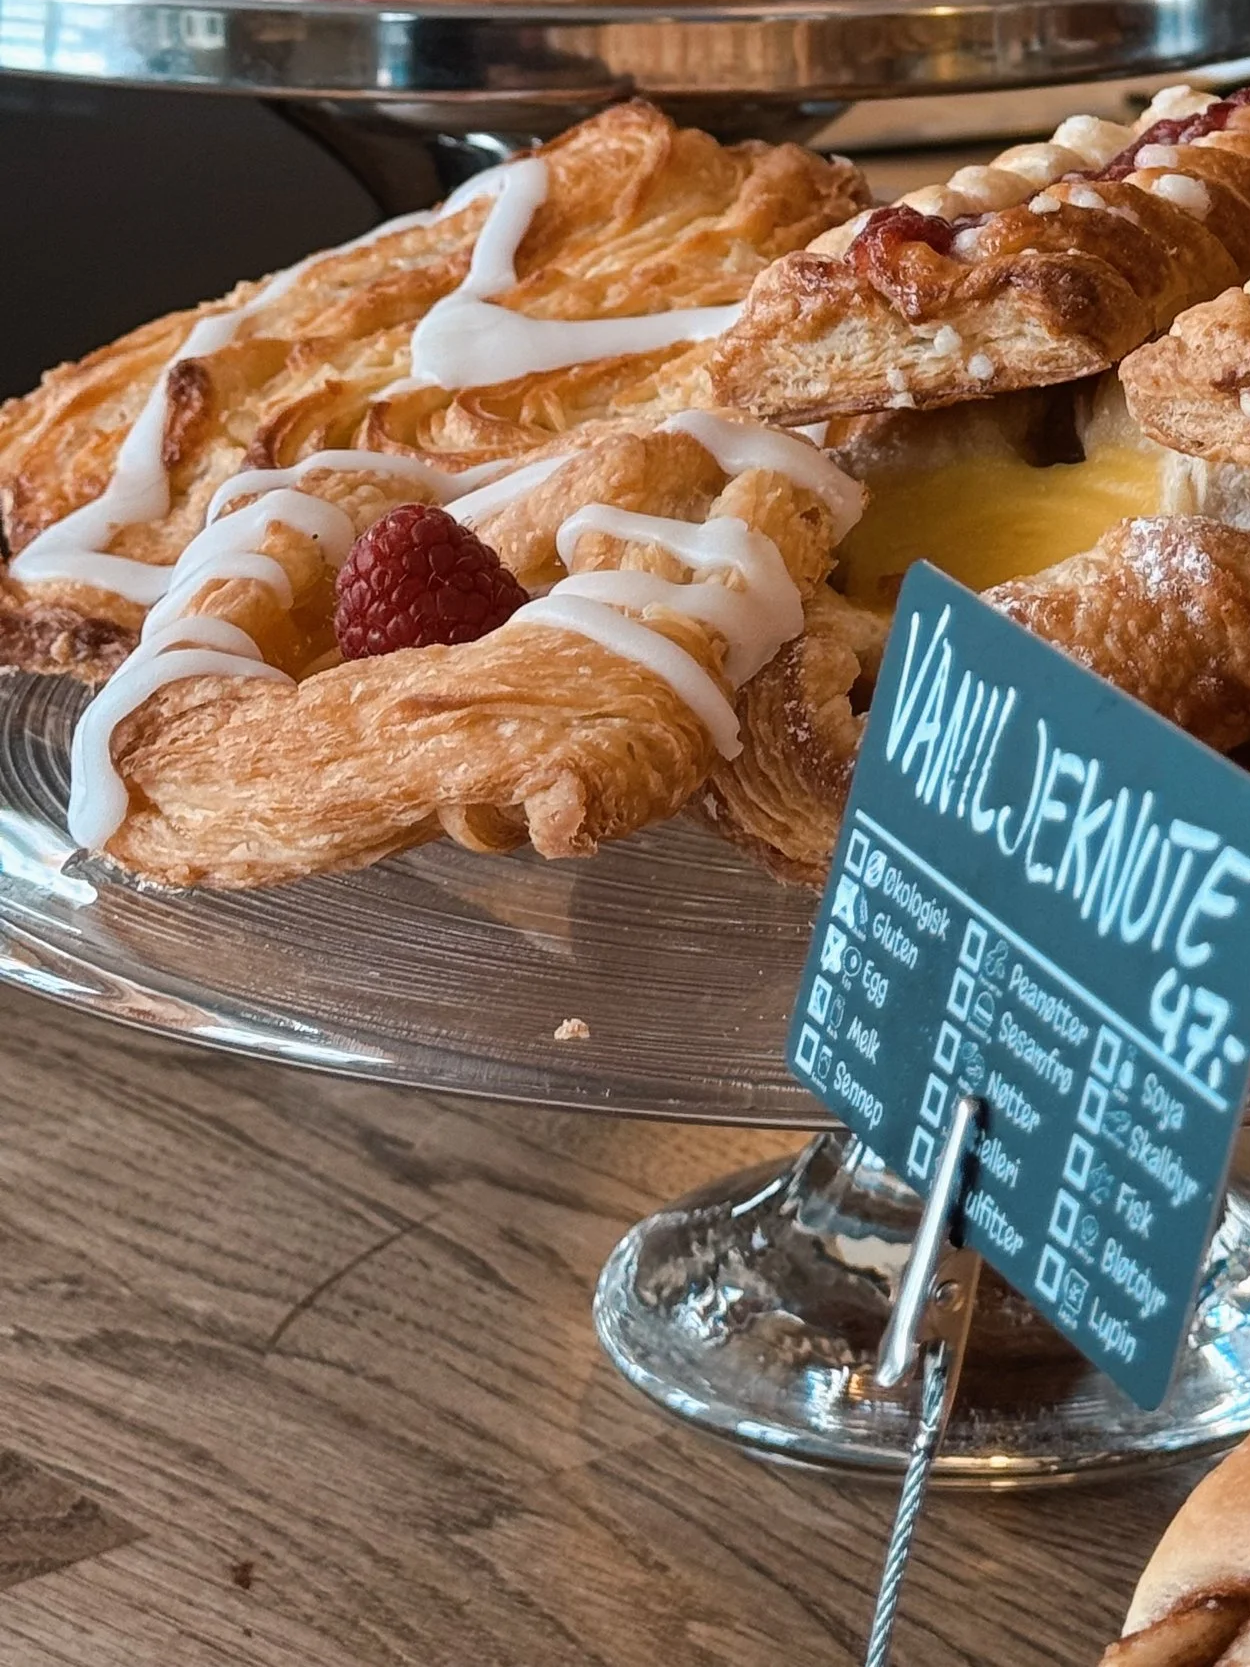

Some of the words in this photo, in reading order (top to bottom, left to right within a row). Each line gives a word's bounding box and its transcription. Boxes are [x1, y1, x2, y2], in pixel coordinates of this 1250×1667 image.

[883, 866, 951, 941] Økologisk
[873, 912, 920, 971] Gluten
[862, 961, 890, 1009] Egg
[1008, 963, 1090, 1047] Peanøtter
[846, 1015, 881, 1065] Melk
[998, 1011, 1074, 1096] Sesamfrø
[833, 1061, 884, 1131] Sennep
[985, 1070, 1041, 1134] Nøtter
[1141, 1072, 1186, 1132] Soya
[1127, 1124, 1199, 1209] Skalldyr
[965, 1189, 1024, 1257] ulfitter
[1114, 1182, 1155, 1239] Fisk
[1101, 1237, 1167, 1320] Bløtdyr
[1087, 1295, 1138, 1364] Lupin
